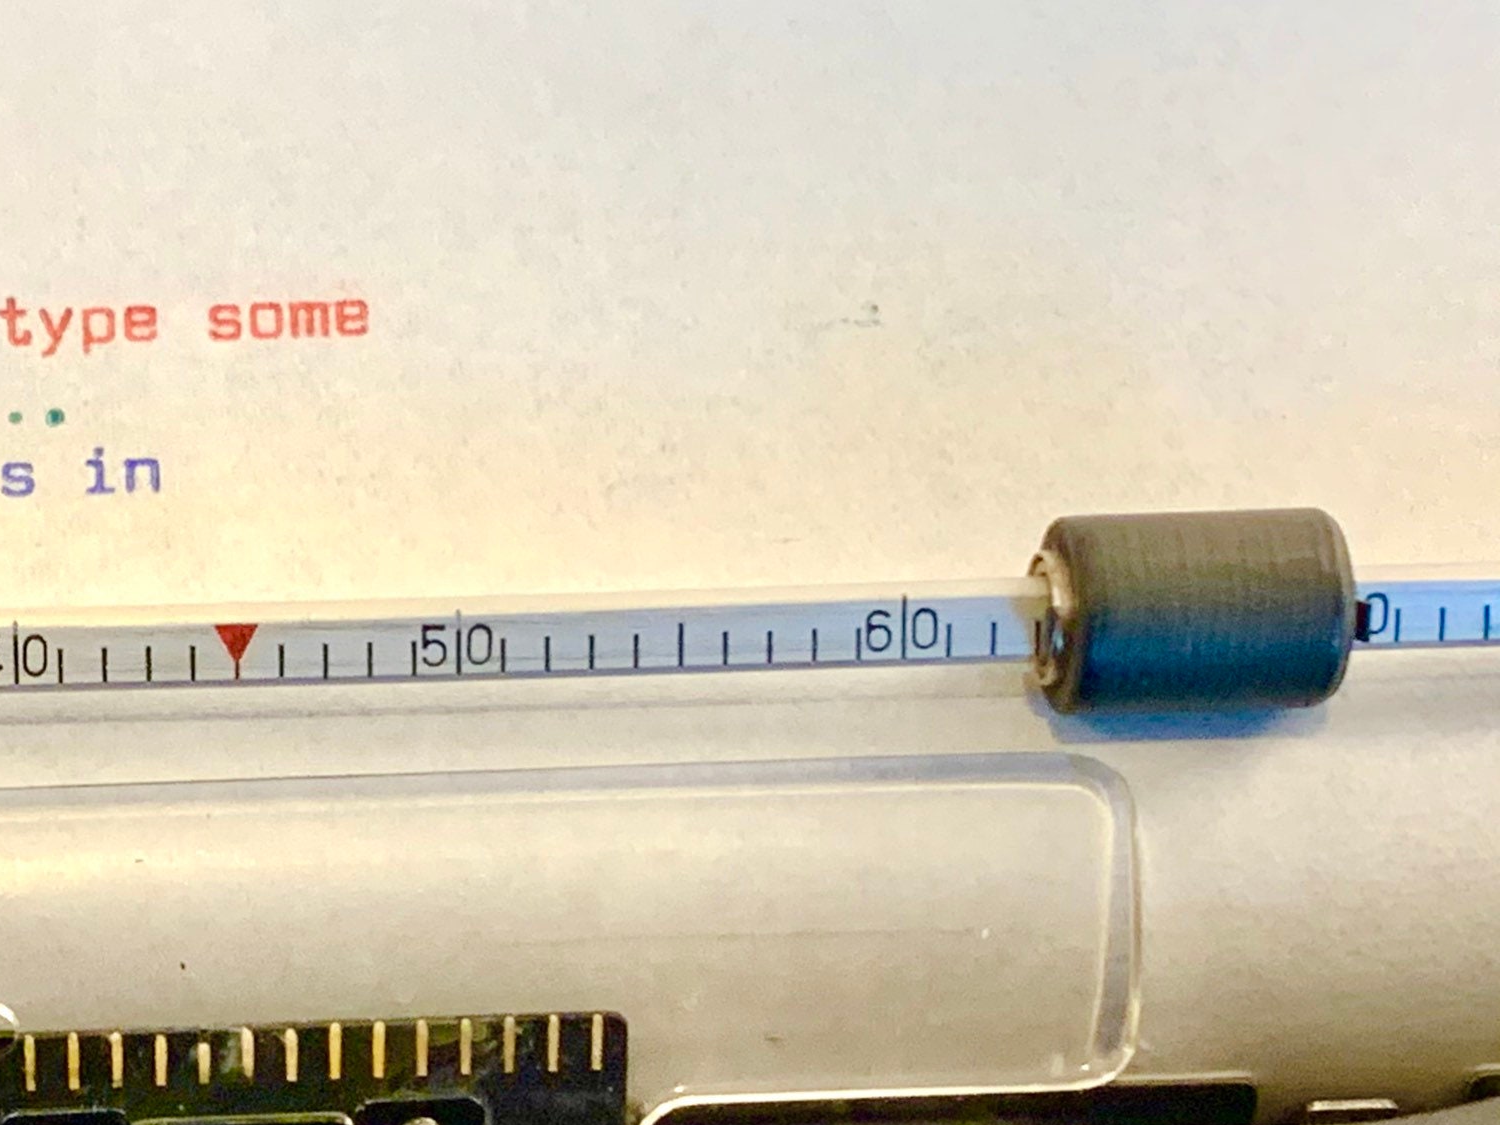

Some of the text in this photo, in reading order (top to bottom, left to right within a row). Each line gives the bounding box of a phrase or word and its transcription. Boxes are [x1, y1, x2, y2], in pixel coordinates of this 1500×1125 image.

[207, 299, 370, 342] some
[85, 447, 162, 496] in
[420, 623, 493, 667] 50
[865, 607, 939, 653] 60
